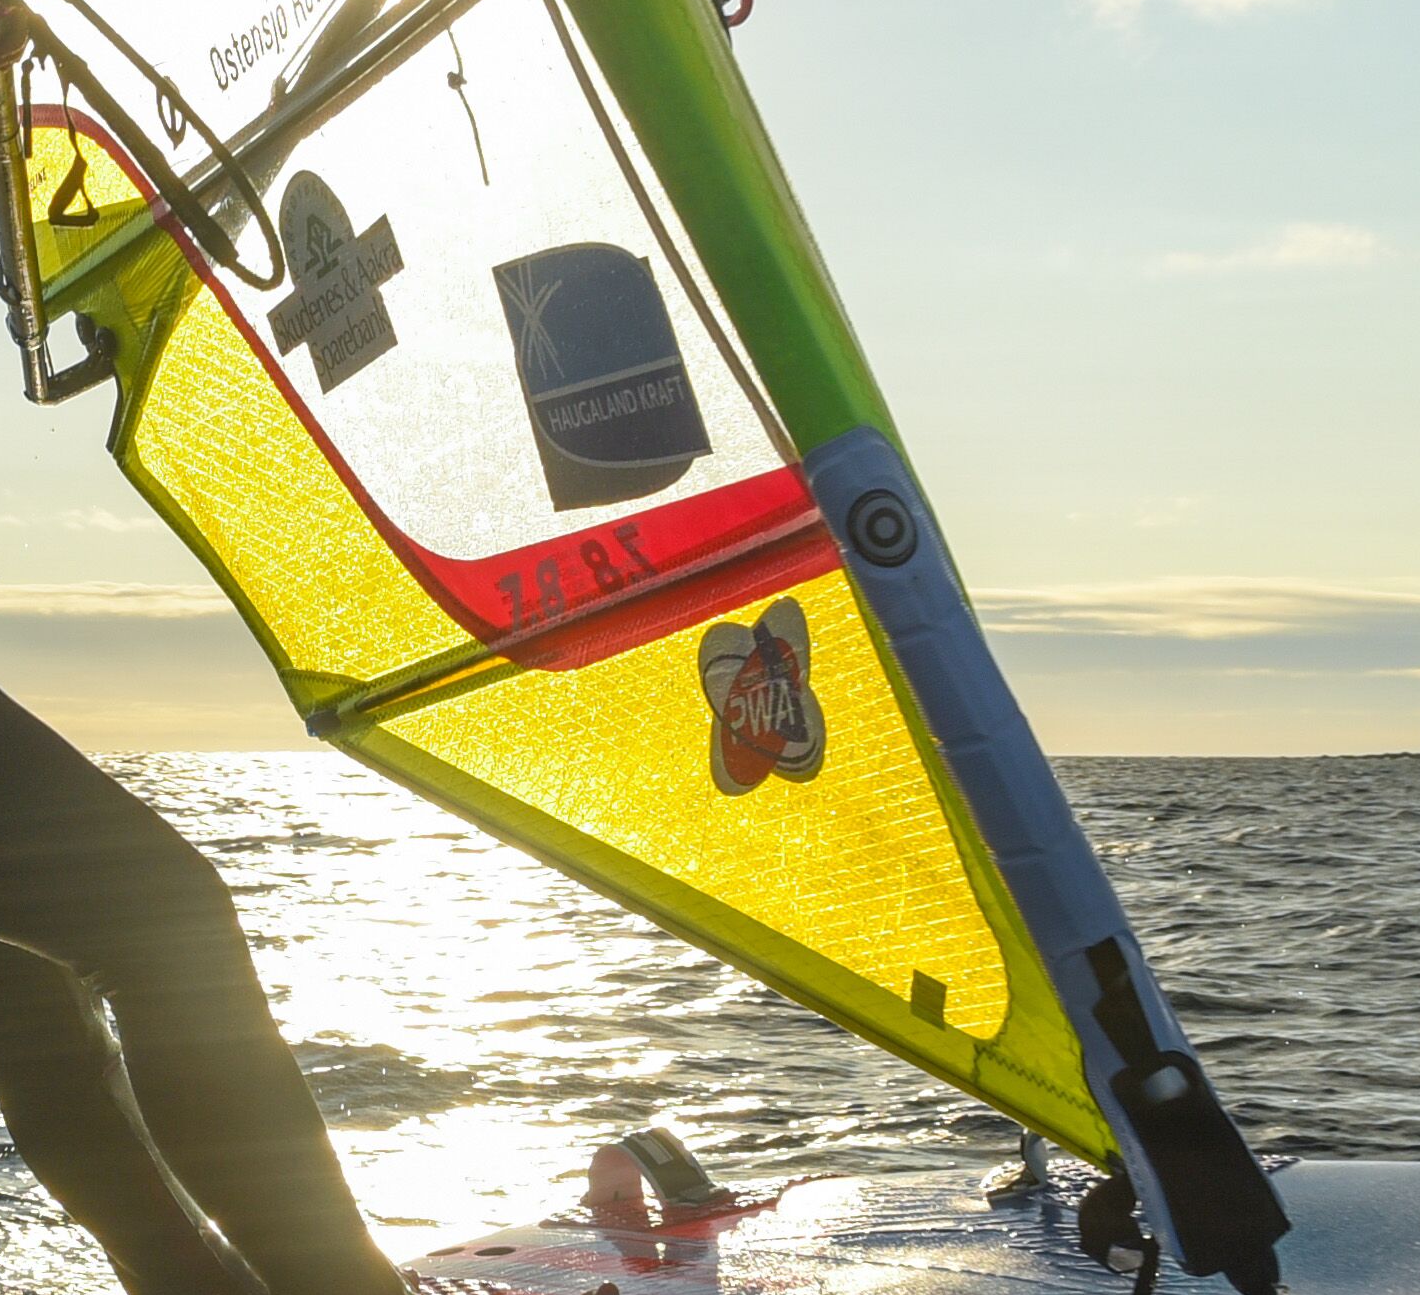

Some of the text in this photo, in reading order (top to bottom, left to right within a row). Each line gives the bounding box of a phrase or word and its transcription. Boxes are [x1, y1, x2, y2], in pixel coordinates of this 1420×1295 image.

[342, 267, 359, 302] &
[312, 297, 391, 385] Sparebank
[548, 375, 685, 433] HAUGALAND KRAFT
